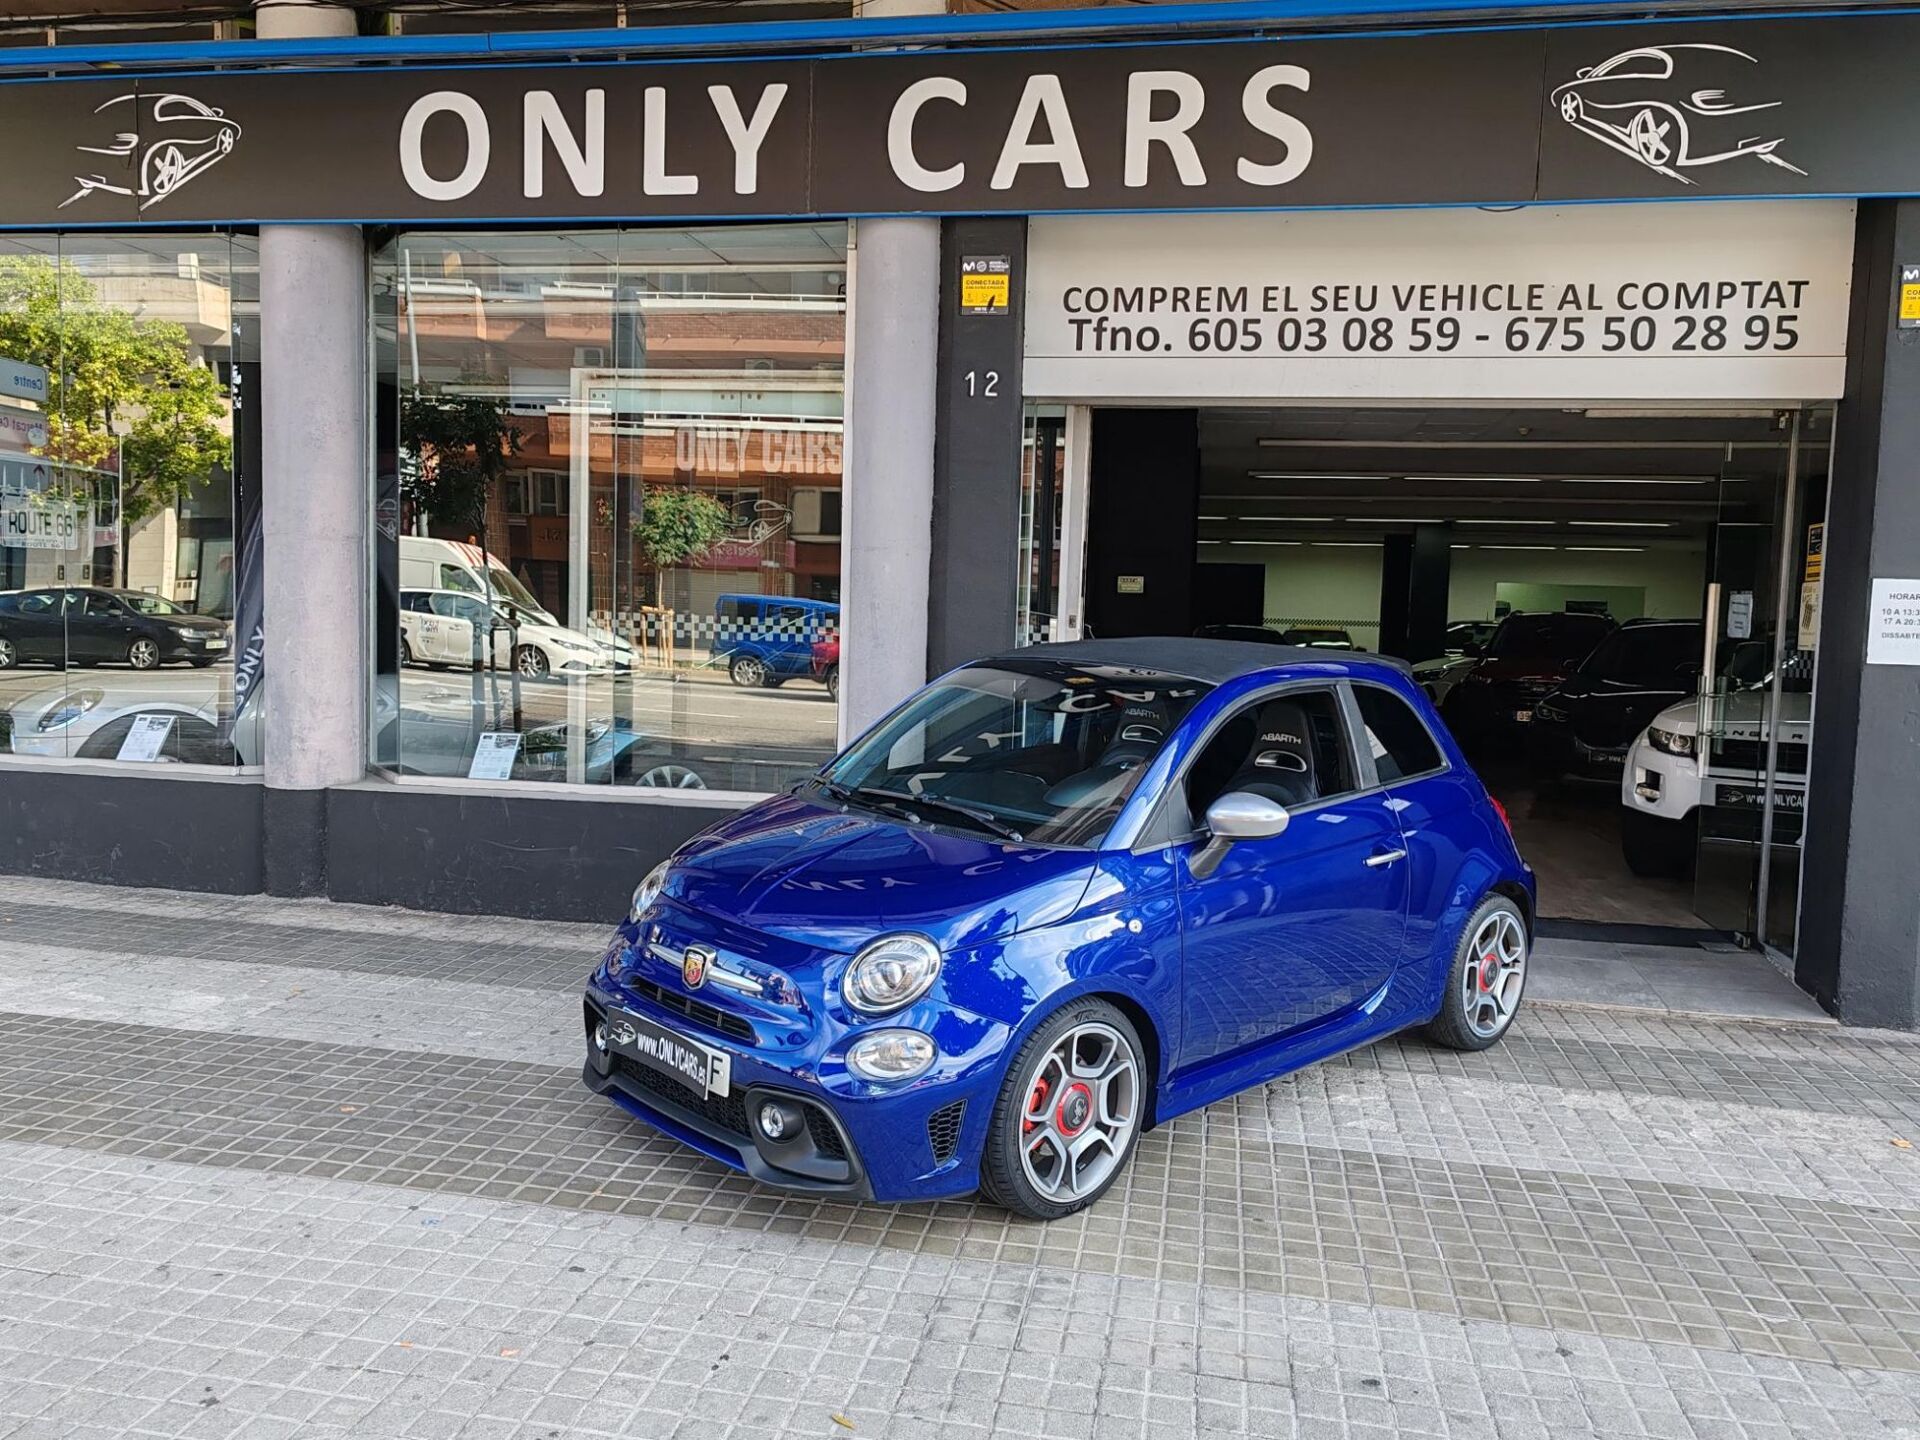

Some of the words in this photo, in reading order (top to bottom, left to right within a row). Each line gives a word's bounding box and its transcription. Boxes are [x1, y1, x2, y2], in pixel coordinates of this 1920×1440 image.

[399, 83, 789, 201] ONLY
[887, 64, 1314, 193] CARS
[1063, 286, 1248, 313] COMPREM
[1262, 286, 1299, 312] EL
[1310, 285, 1378, 312] SEU
[1392, 283, 1545, 312] VEHICLE
[1557, 283, 1603, 311] AL
[1617, 280, 1810, 311] COMPTAT
[1068, 316, 1173, 352] Tfno.
[1188, 318, 1263, 352] 605
[1277, 317, 1327, 352] 03
[1342, 317, 1394, 352] 08
[1409, 317, 1460, 352] 59
[1505, 316, 1585, 352] 675
[1601, 315, 1656, 352] 50
[1672, 315, 1727, 351] 28
[1744, 314, 1799, 351] 95
[964, 371, 999, 397] 12
[676, 427, 750, 472] ONLY
[762, 429, 843, 473] CARS
[9, 511, 51, 535] ROUTE
[57, 513, 72, 537] 66
[235, 625, 265, 691] ONLY
[1124, 708, 1160, 720] ABARTH
[1261, 733, 1302, 745] ABARTH
[638, 1033, 706, 1086] www.ONLYCARS.es
[710, 1055, 723, 1085] F
